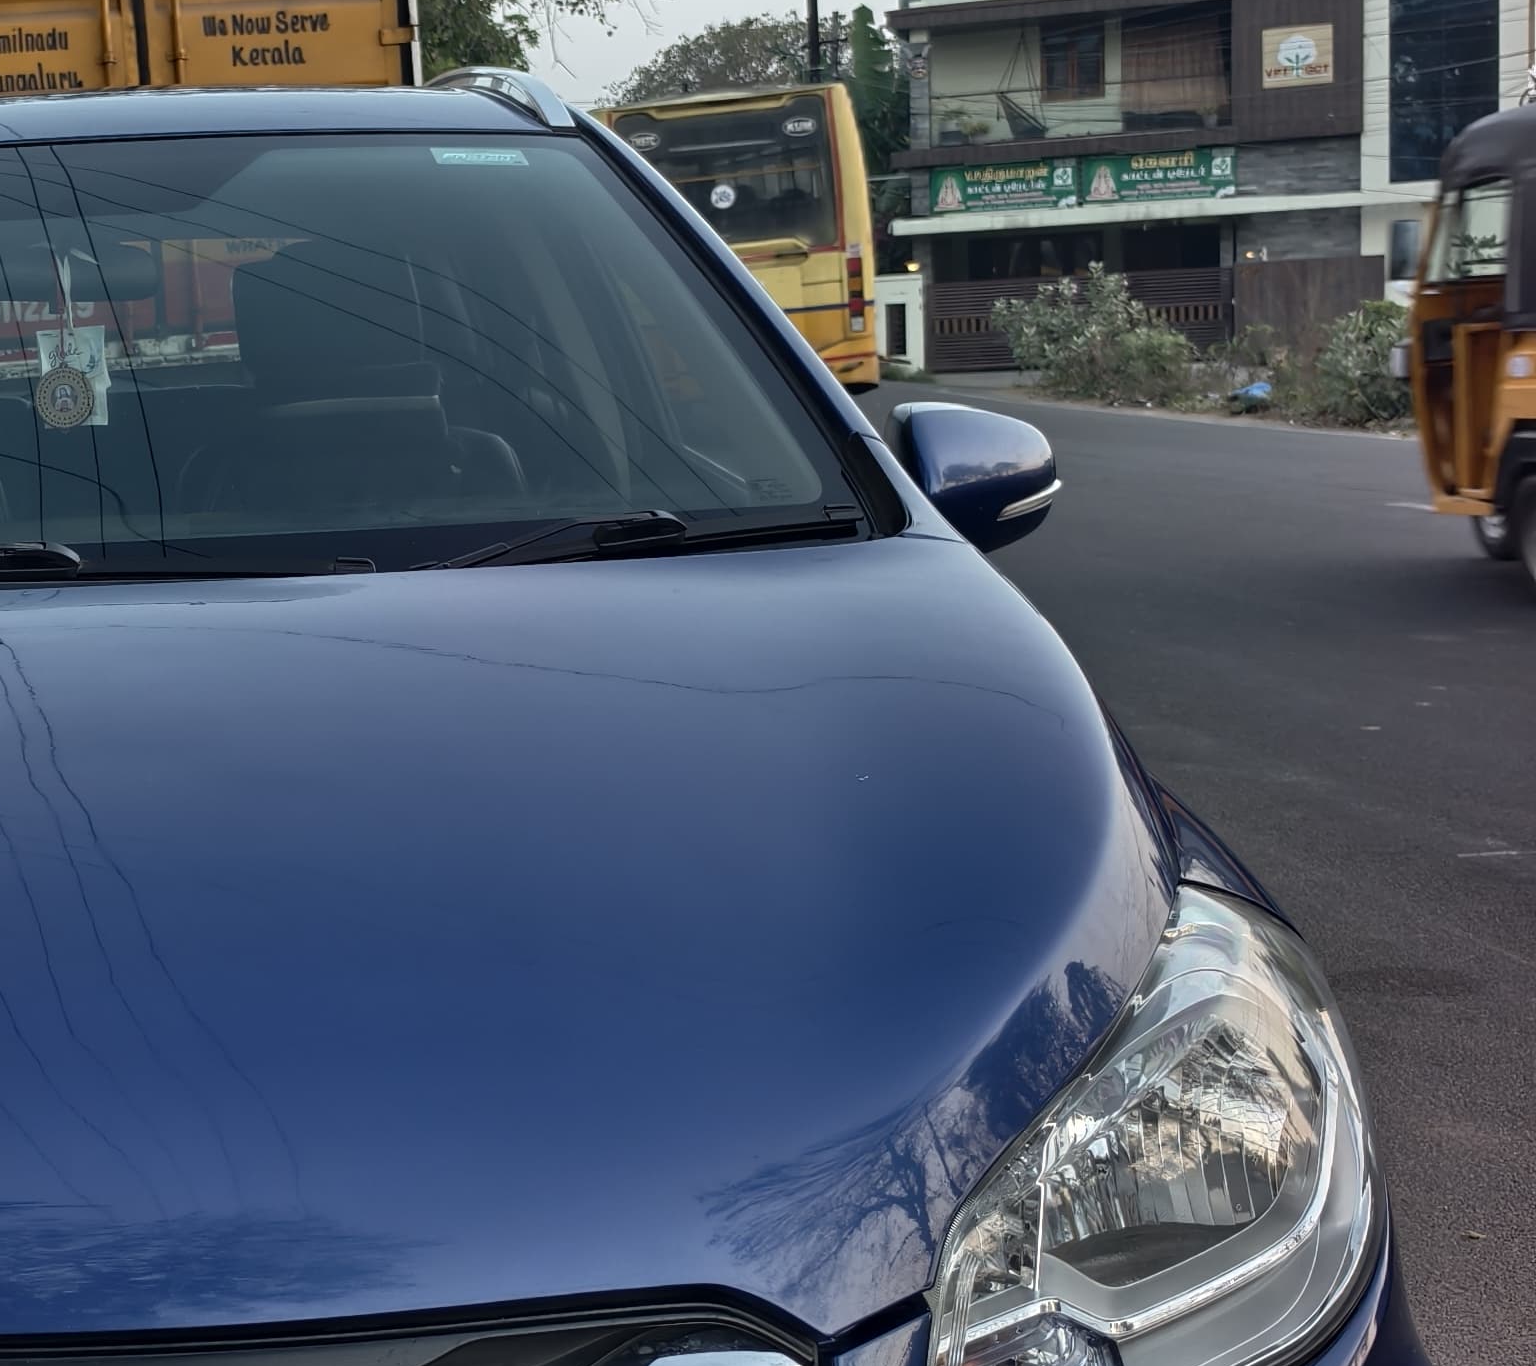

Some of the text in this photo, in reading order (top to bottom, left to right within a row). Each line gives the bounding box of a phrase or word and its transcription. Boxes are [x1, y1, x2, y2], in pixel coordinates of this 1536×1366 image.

[202, 11, 330, 37] We Now Serve
[232, 40, 306, 67] Kerala
